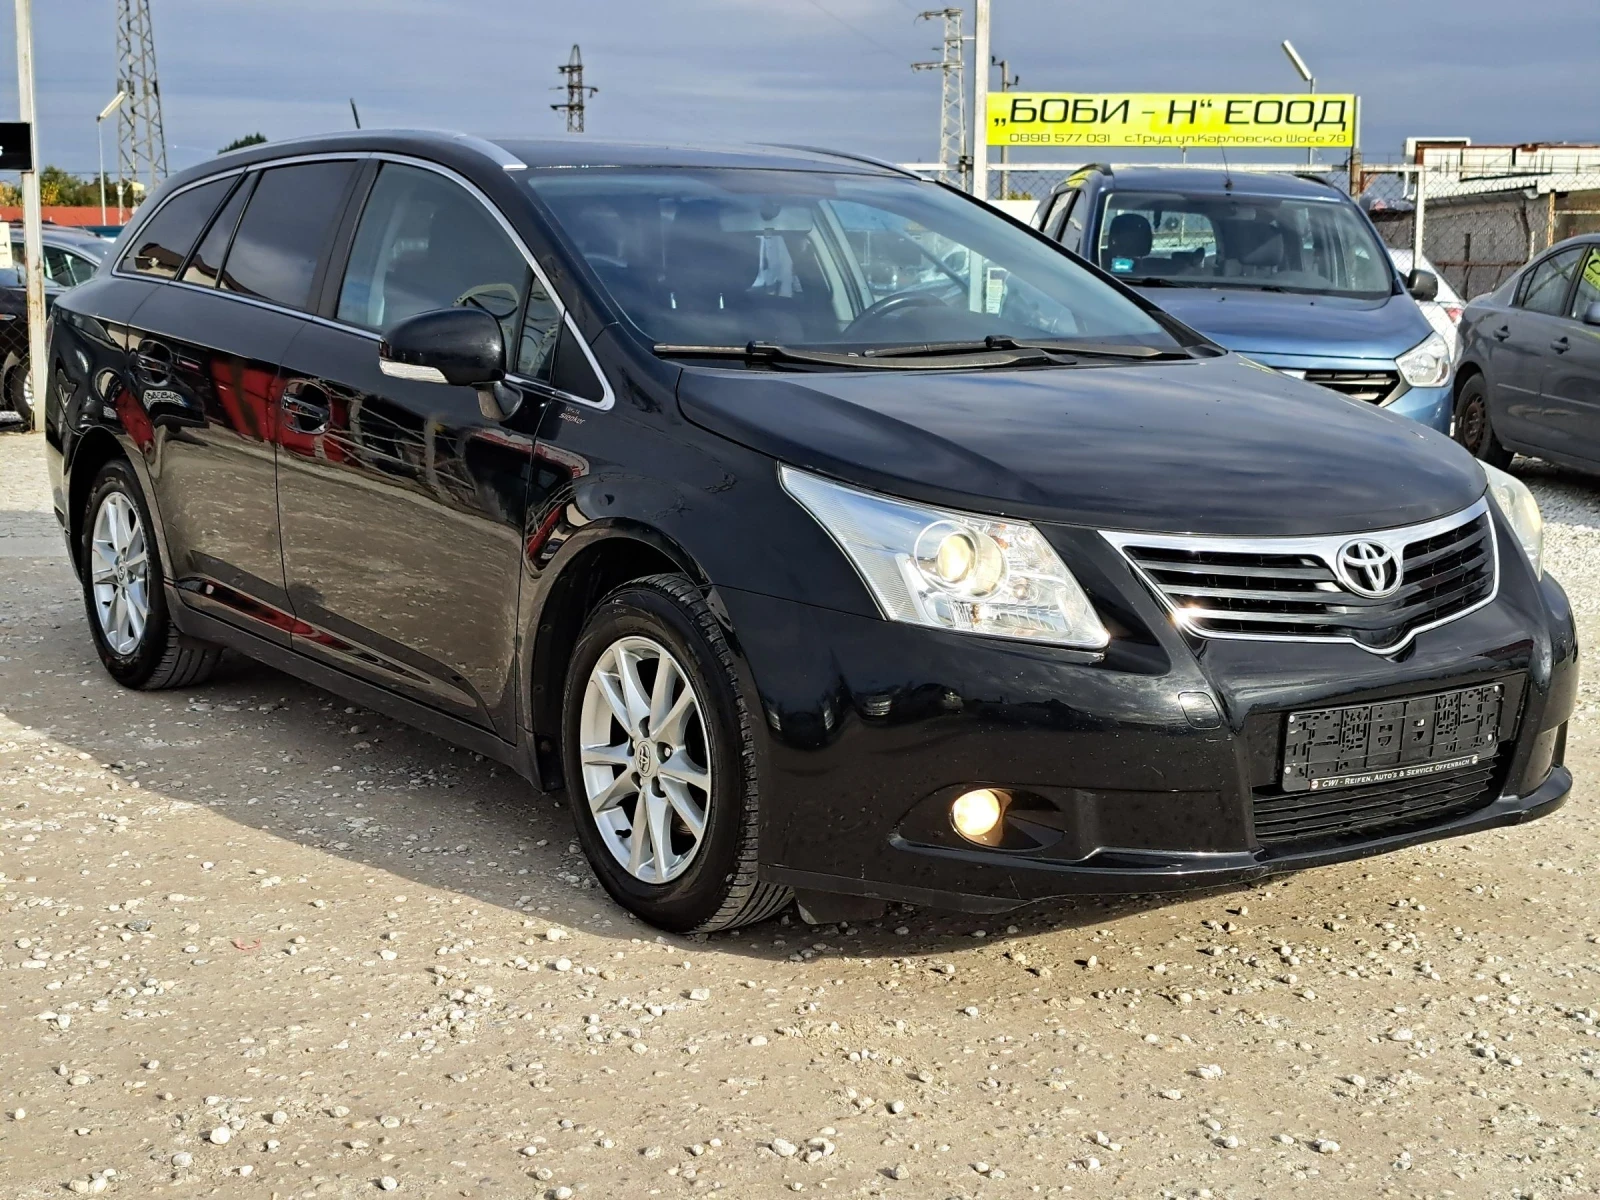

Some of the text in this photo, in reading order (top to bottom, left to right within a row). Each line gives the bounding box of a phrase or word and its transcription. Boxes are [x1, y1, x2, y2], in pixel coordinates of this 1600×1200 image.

[1224, 100, 1347, 132] ЕООД
[1009, 133, 1050, 143] 0898
[1054, 133, 1082, 143] 577
[1086, 133, 1111, 143] 031
[1124, 133, 1172, 145] с.Труд
[1286, 134, 1325, 143] Шосе
[1328, 134, 1347, 143] 78
[1399, 769, 1405, 777] &
[1406, 766, 1434, 776] SERVICE
